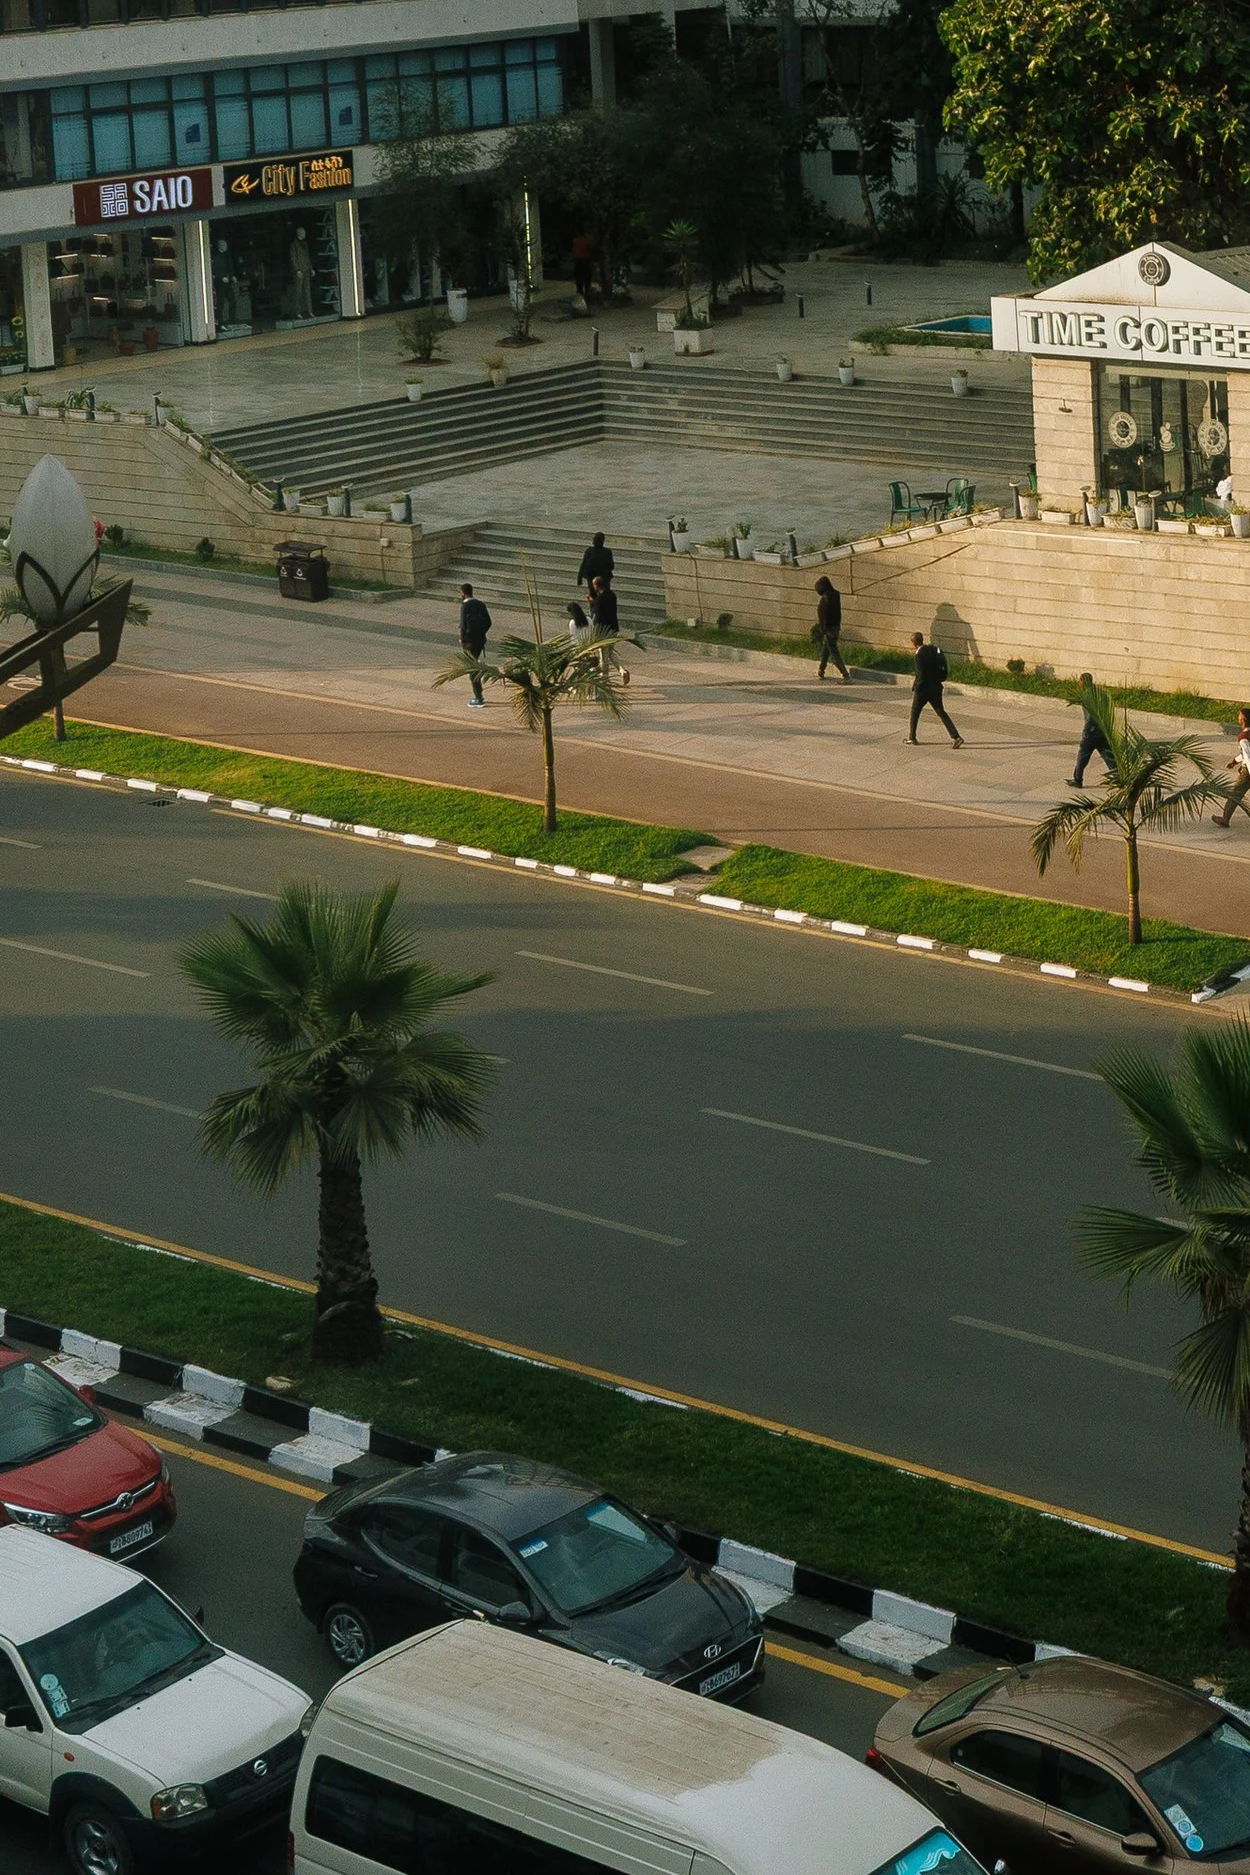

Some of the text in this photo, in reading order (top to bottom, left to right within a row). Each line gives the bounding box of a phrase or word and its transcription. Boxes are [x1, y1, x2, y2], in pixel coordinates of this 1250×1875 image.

[133, 175, 193, 213] SAIO
[262, 161, 352, 196] City Fashion
[1019, 310, 1107, 349] TIME
